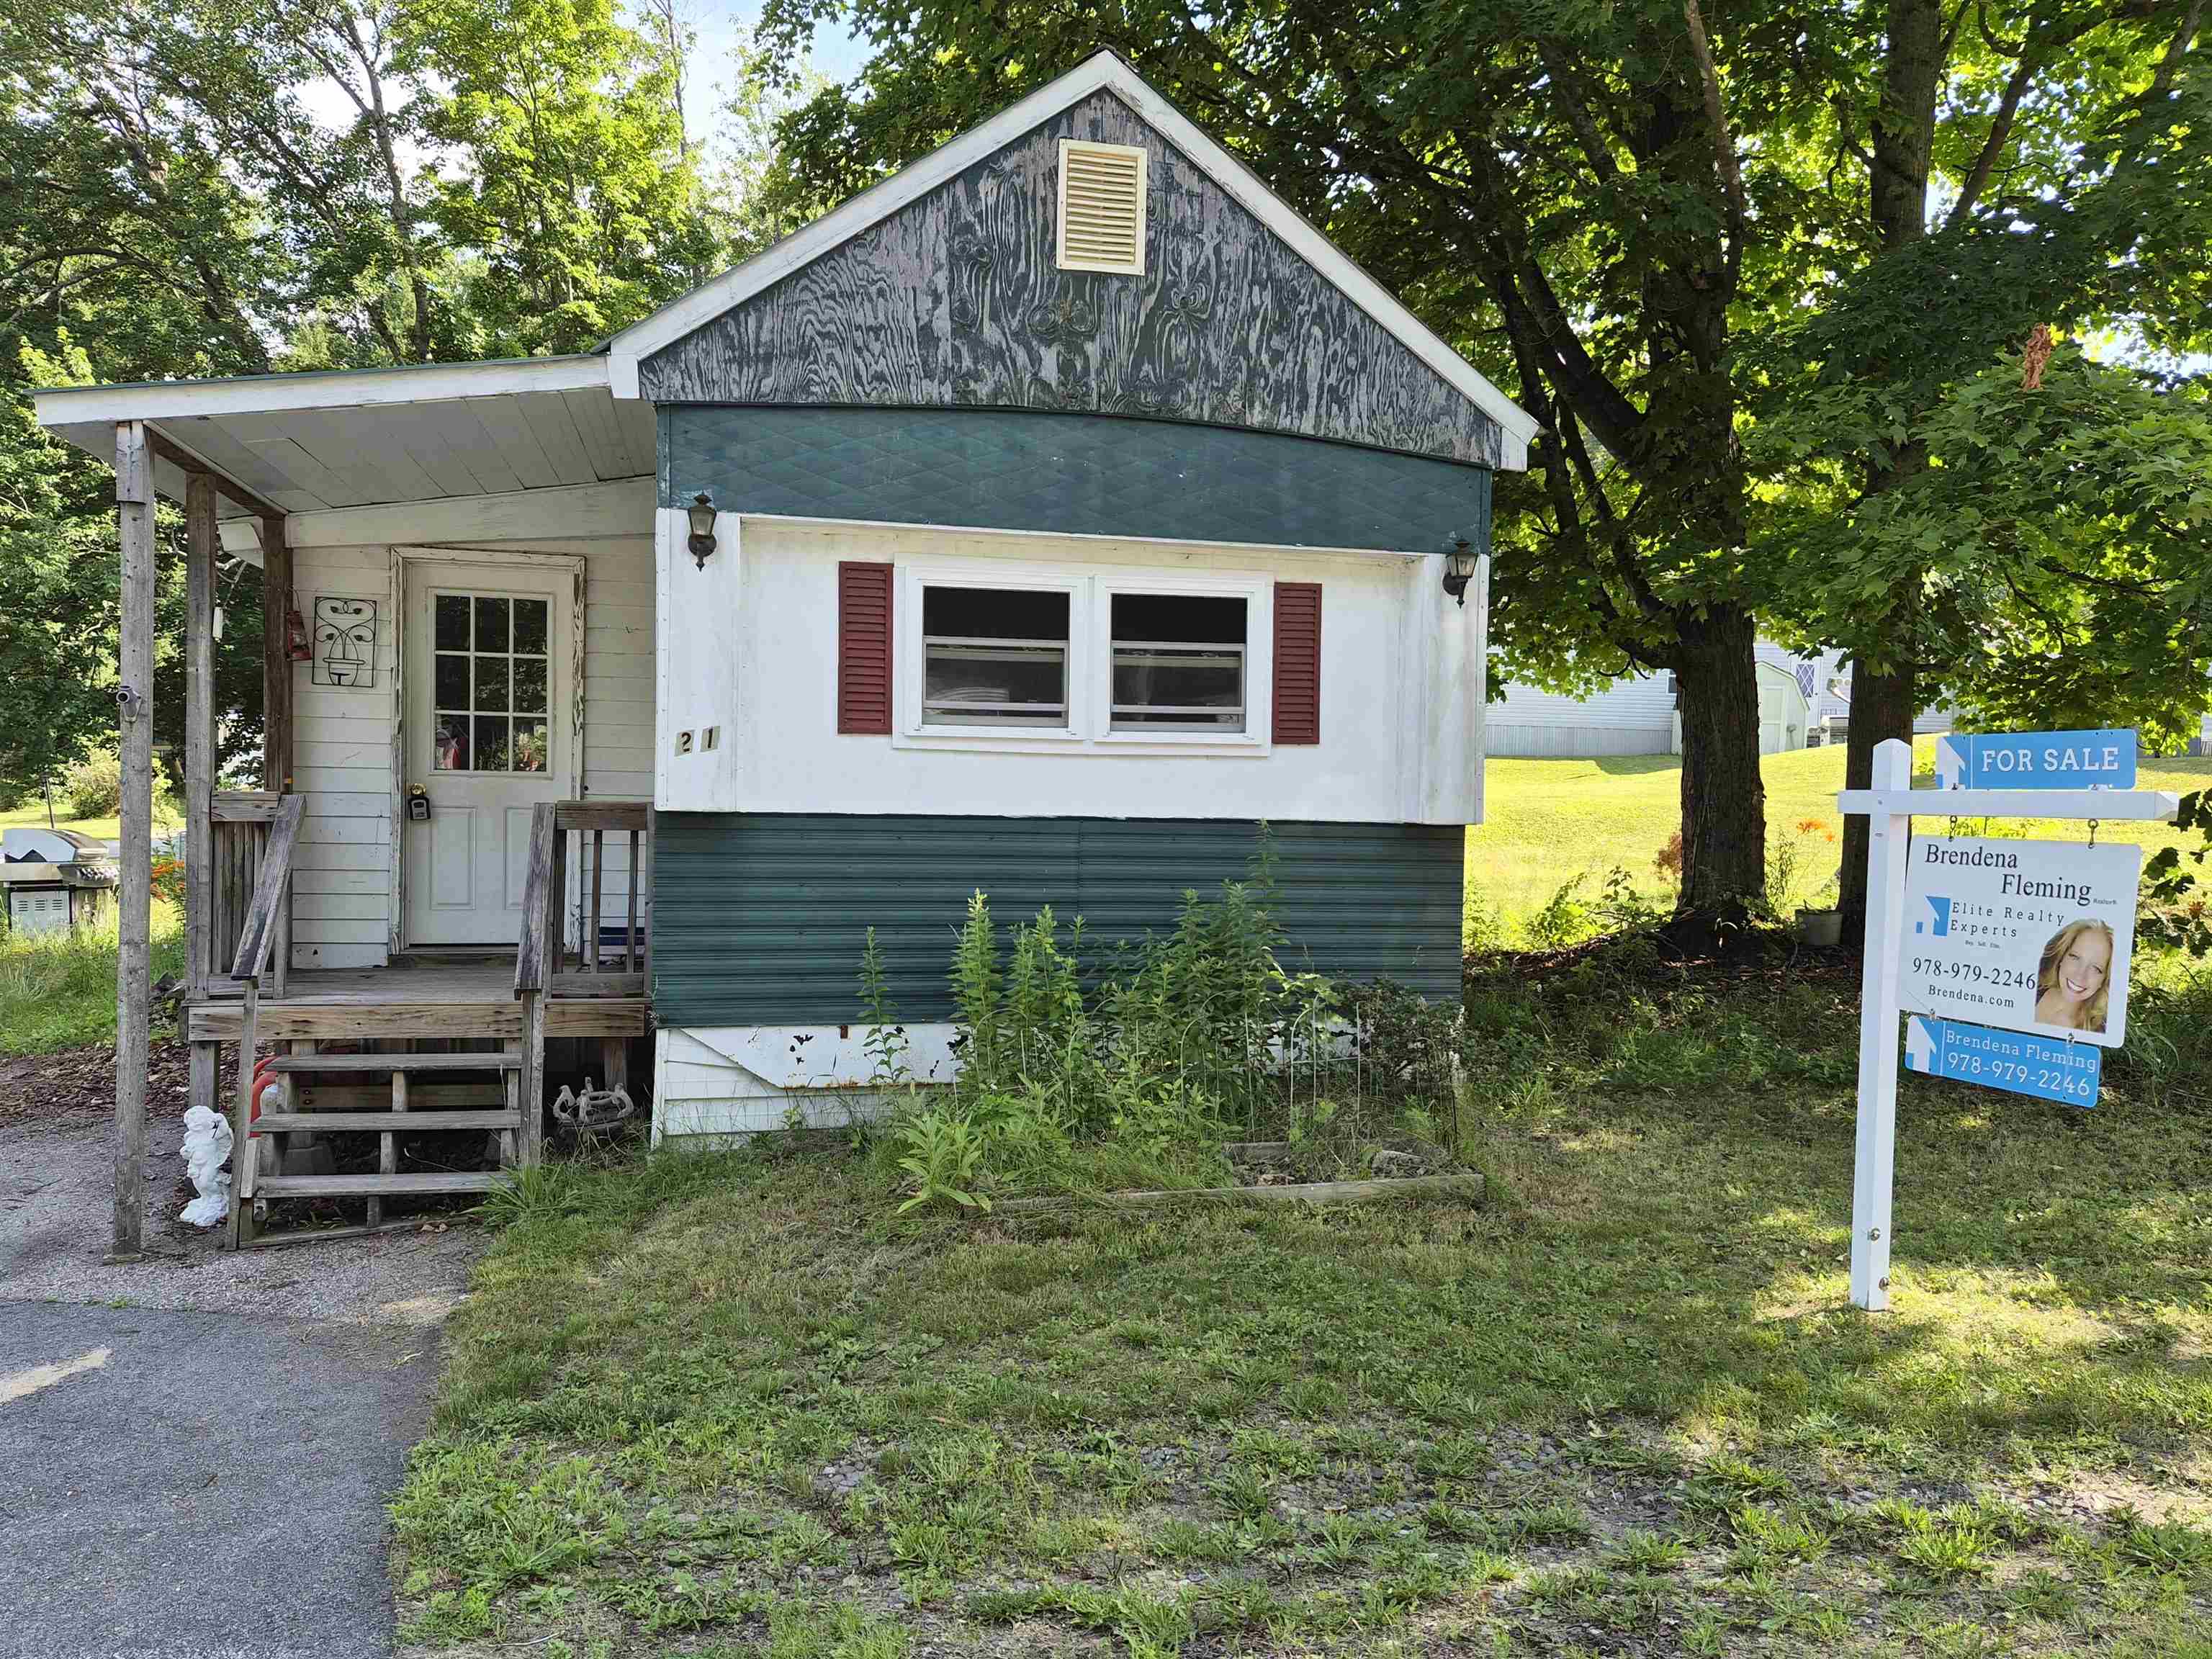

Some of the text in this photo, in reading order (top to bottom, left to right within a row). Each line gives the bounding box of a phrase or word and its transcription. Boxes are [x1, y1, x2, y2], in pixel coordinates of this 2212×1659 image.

[681, 727, 714, 752] 21
[1982, 747, 2119, 772] FOR SALE
[1925, 843, 2018, 868] Brendena
[2000, 873, 2092, 907] Fleming
[1952, 902, 2064, 926] Elite Realty
[1950, 920, 2017, 937] Experts
[1912, 957, 2036, 990] 978-979-2246
[1928, 984, 2015, 1008] Brendena.com
[1946, 1030, 2097, 1073] Brendena Fleming
[1947, 1052, 2090, 1096] 978-979-2246
